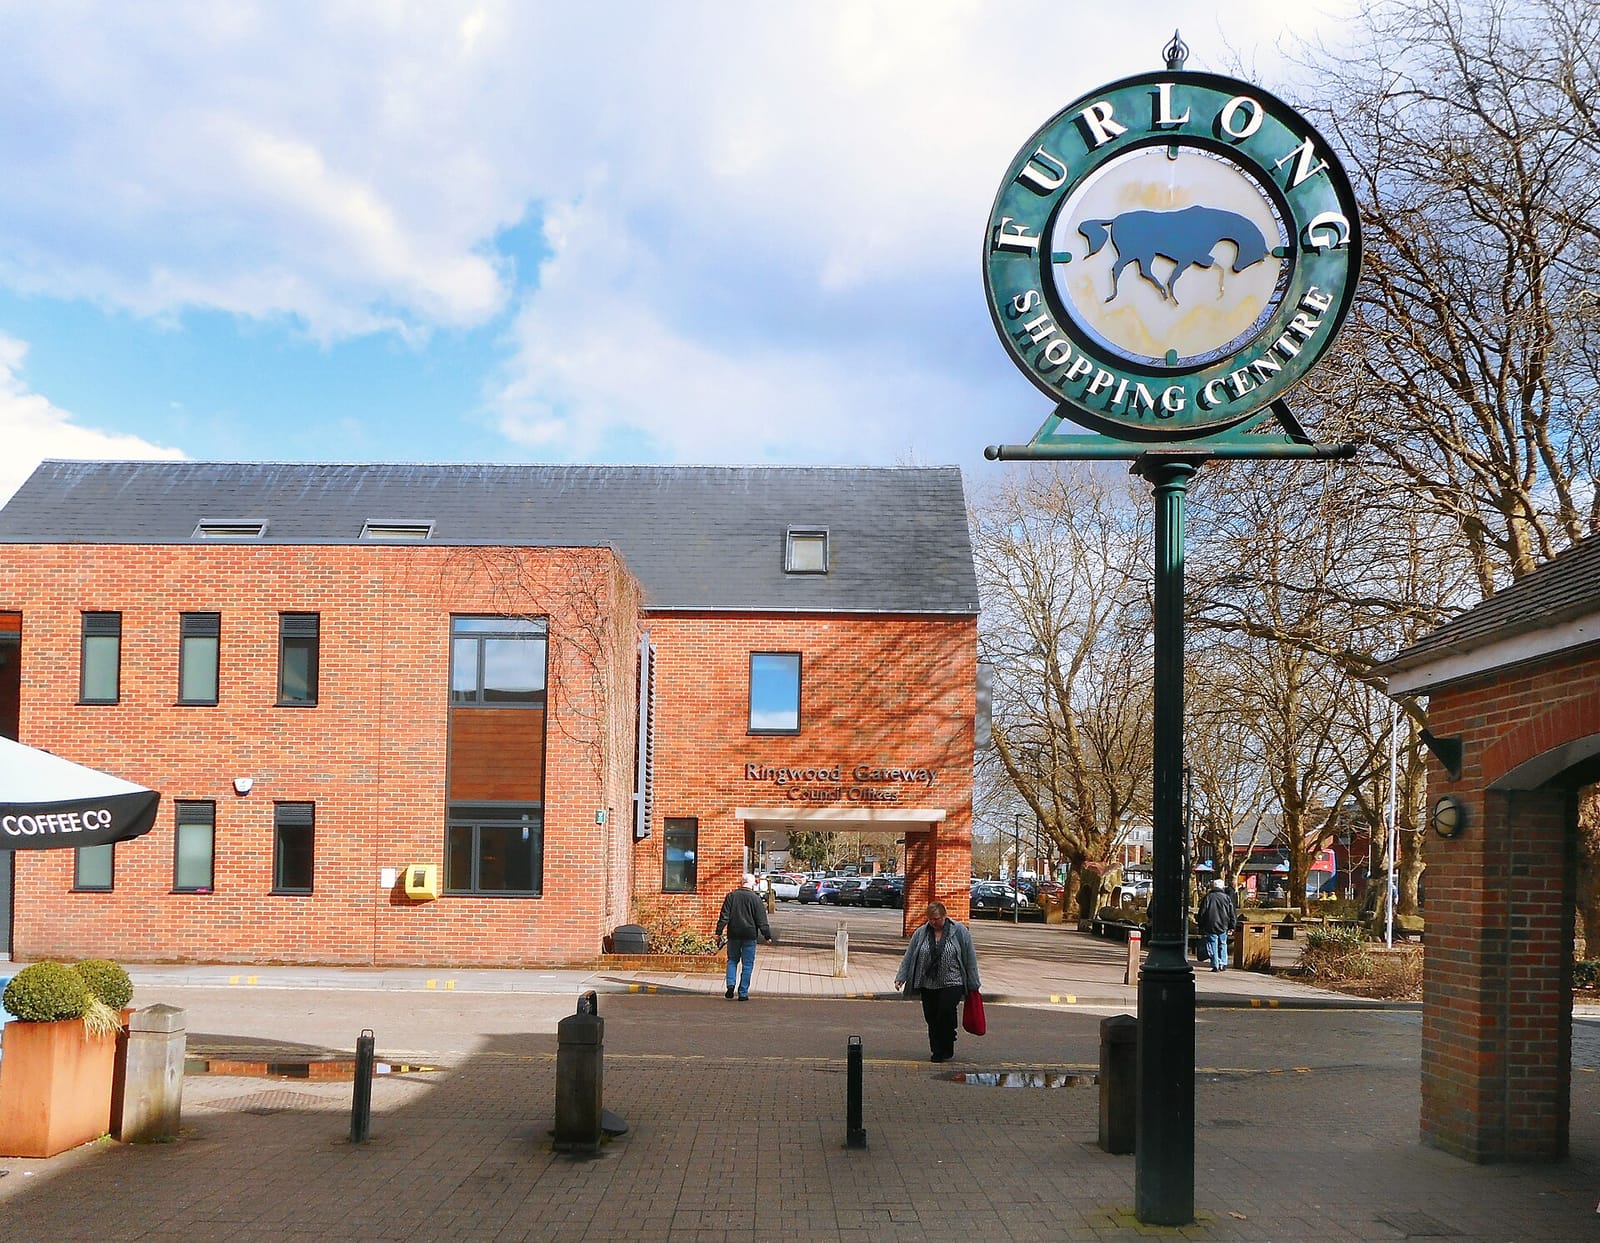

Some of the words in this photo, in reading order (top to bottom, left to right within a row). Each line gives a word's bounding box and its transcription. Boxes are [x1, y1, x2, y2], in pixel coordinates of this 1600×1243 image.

[997, 82, 1352, 258] FURLONG
[1012, 288, 1187, 412] SHOPPING
[1203, 286, 1335, 405] CENTRE
[745, 763, 841, 784] Ringwood
[853, 763, 939, 786] Gateway
[787, 786, 840, 800] Council
[847, 787, 899, 801] Offices
[2, 812, 82, 836] COFFEE
